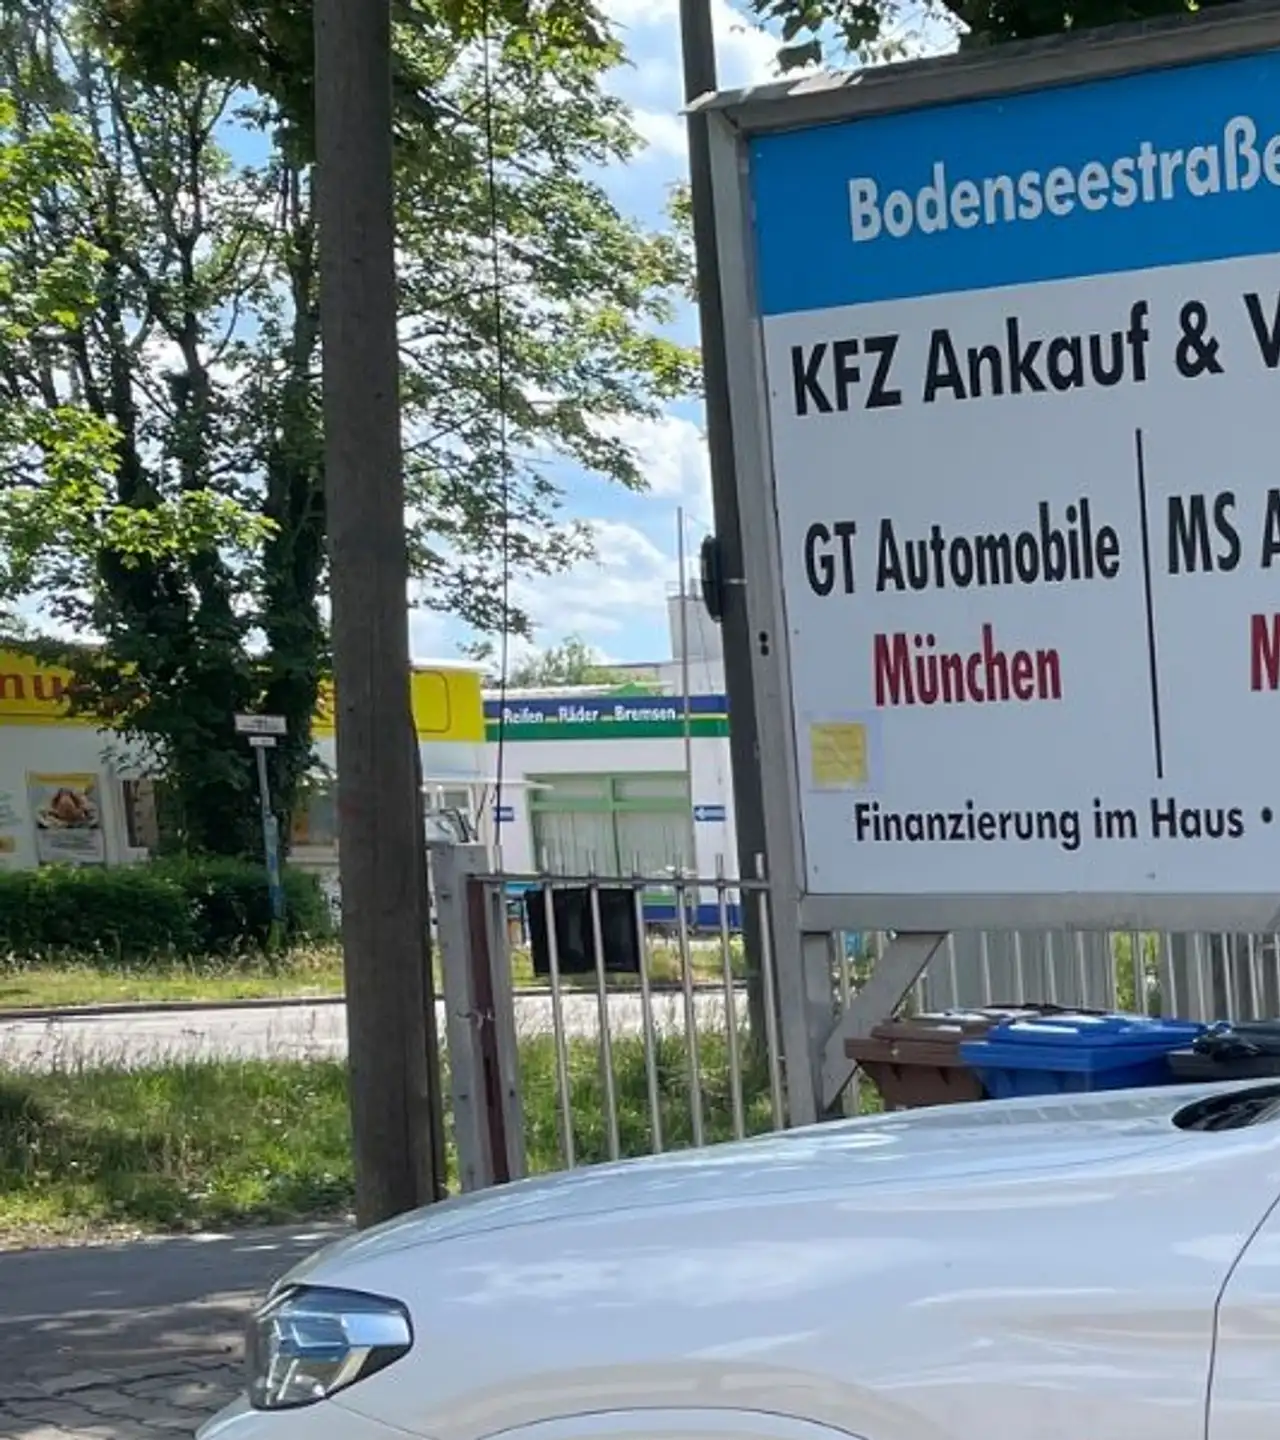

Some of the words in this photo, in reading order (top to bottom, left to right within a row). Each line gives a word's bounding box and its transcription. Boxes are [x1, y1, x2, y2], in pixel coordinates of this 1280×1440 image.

[791, 334, 903, 416] KFZ
[924, 300, 1150, 404] Ankauf
[1175, 300, 1225, 378] &
[804, 520, 856, 597] GT
[876, 496, 1121, 593] Automobile
[1167, 490, 1241, 575] MS
[873, 624, 1063, 707] München
[504, 707, 544, 724] Reifen
[559, 706, 598, 723] Räder
[614, 705, 676, 721] Bremsen
[855, 802, 1082, 850] Finanzierung
[1093, 799, 1138, 841] im
[1151, 797, 1244, 840] Haus
